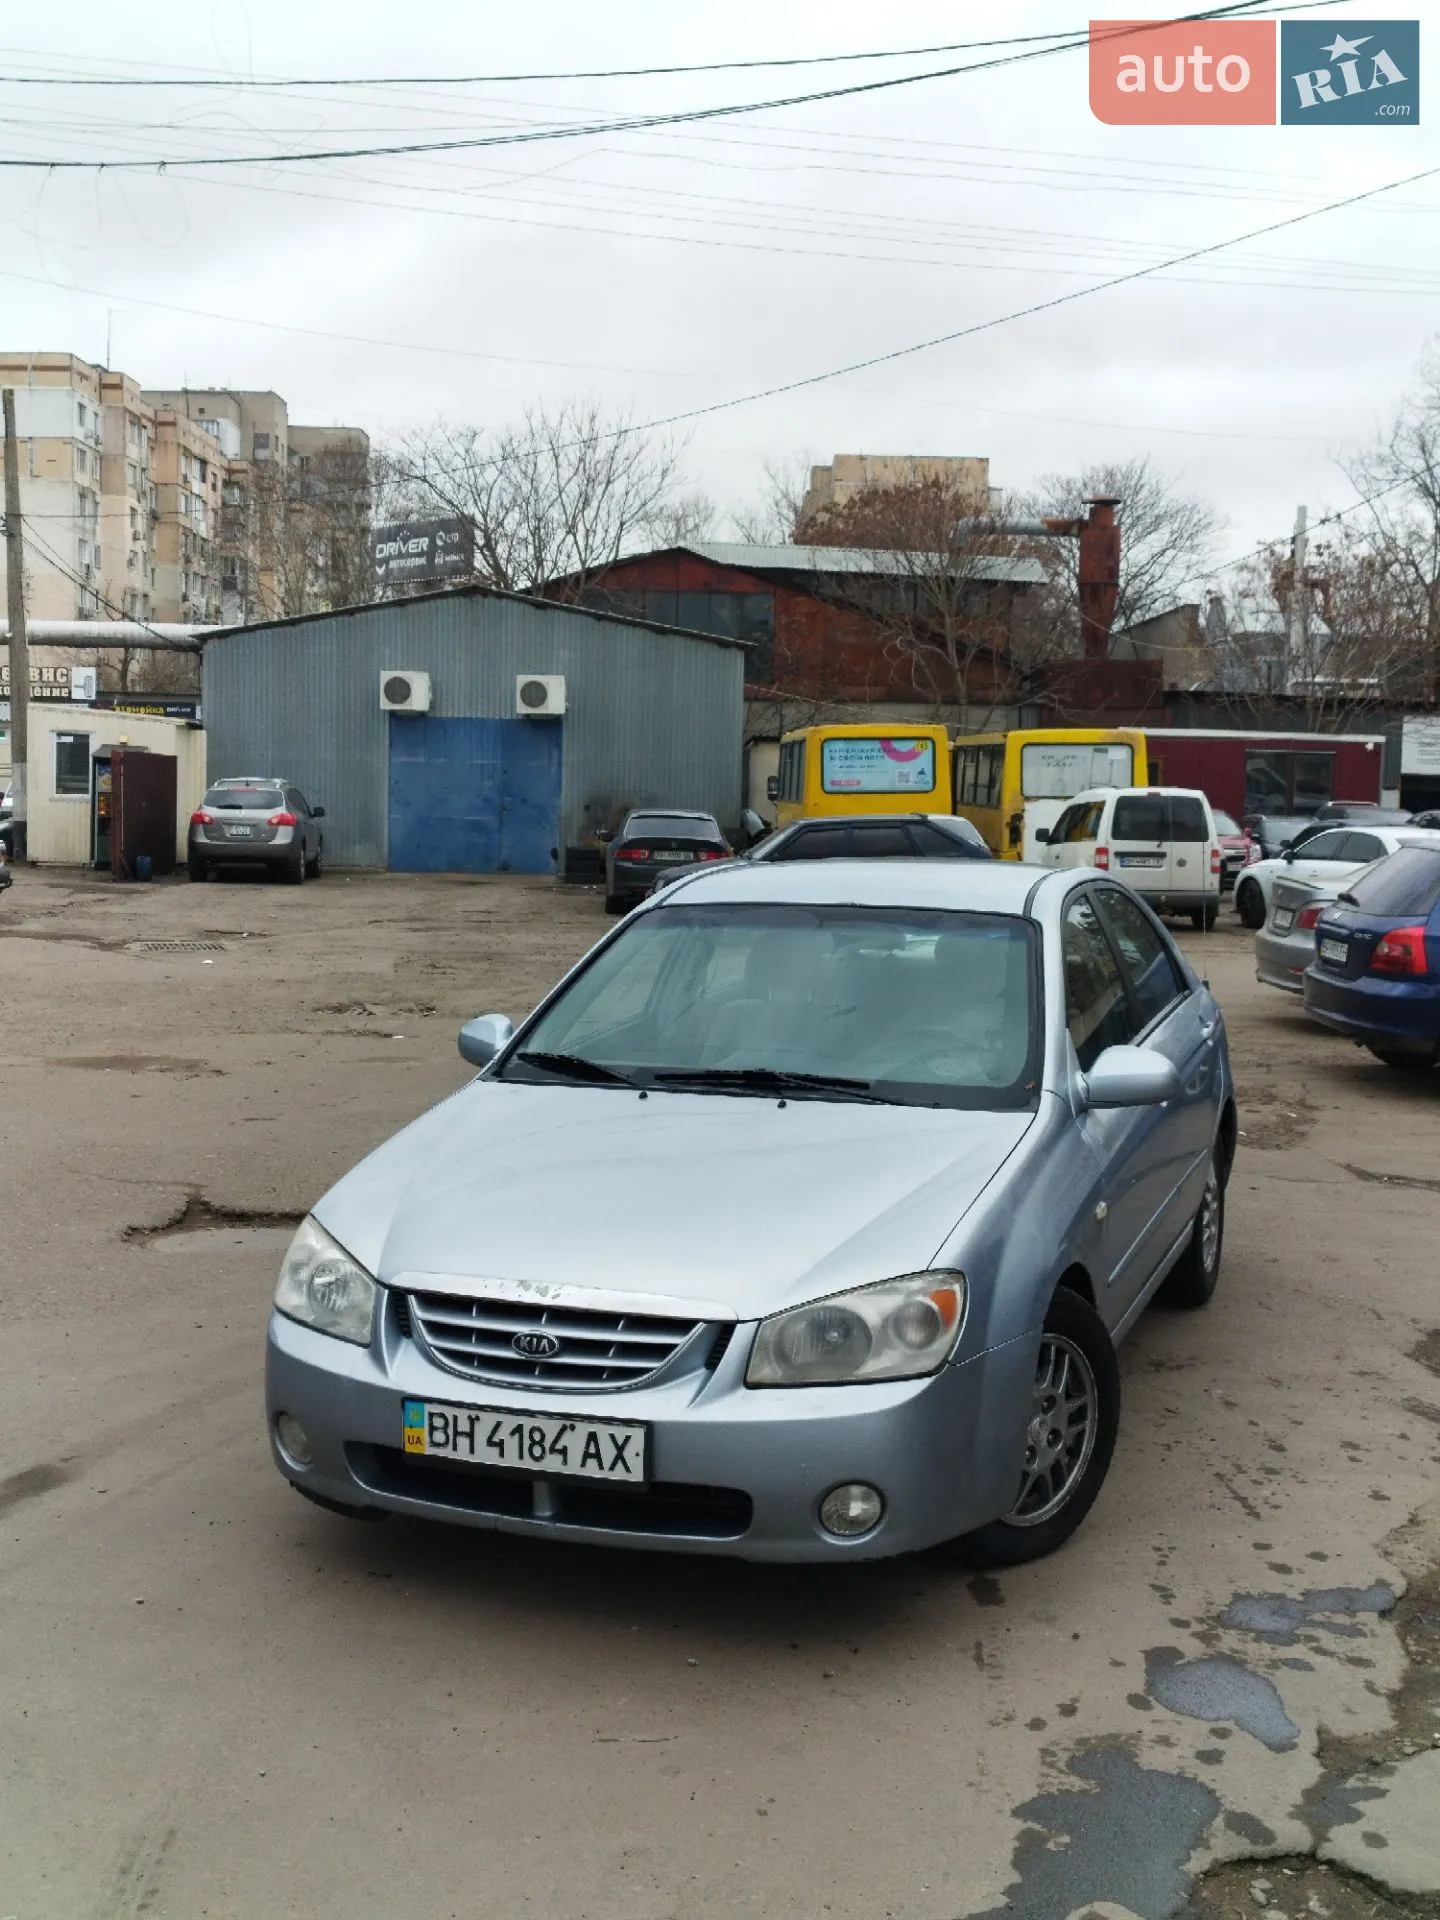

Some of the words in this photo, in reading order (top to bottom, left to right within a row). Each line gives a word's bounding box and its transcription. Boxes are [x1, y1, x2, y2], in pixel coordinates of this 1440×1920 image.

[375, 536, 429, 559] DRIVER
[520, 1336, 549, 1352] KIA
[408, 1434, 423, 1446] UA
[486, 1420, 573, 1466] 4184
[580, 1430, 633, 1474] AX
